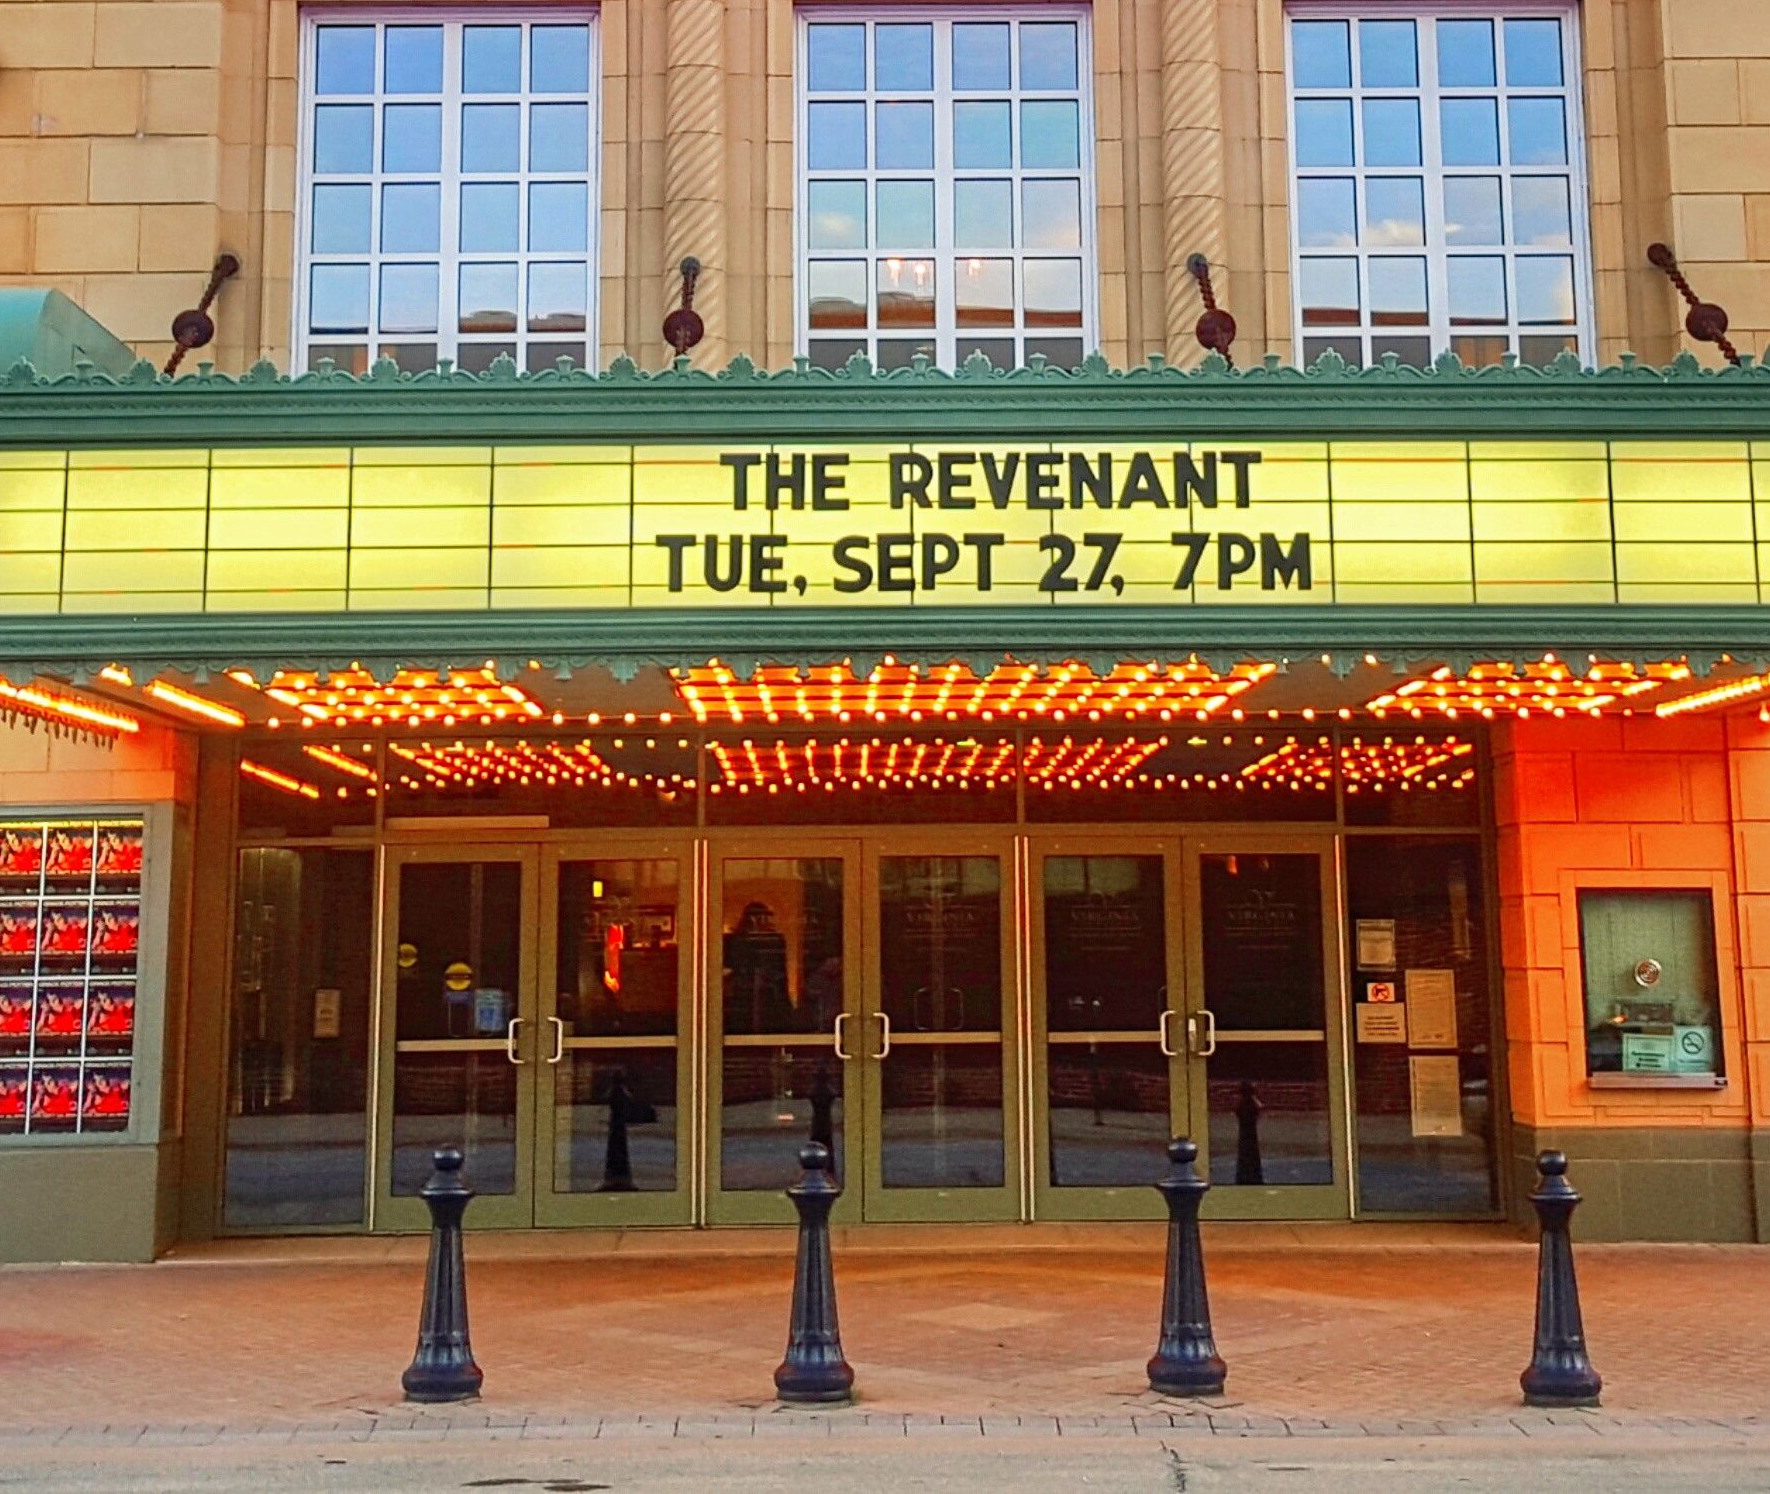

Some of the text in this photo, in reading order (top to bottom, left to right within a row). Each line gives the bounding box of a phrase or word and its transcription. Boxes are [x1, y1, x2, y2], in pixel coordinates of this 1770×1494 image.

[720, 452, 1262, 511] THE REVENANT
[656, 533, 1312, 596] TUE, SEPT 27, 7PM
